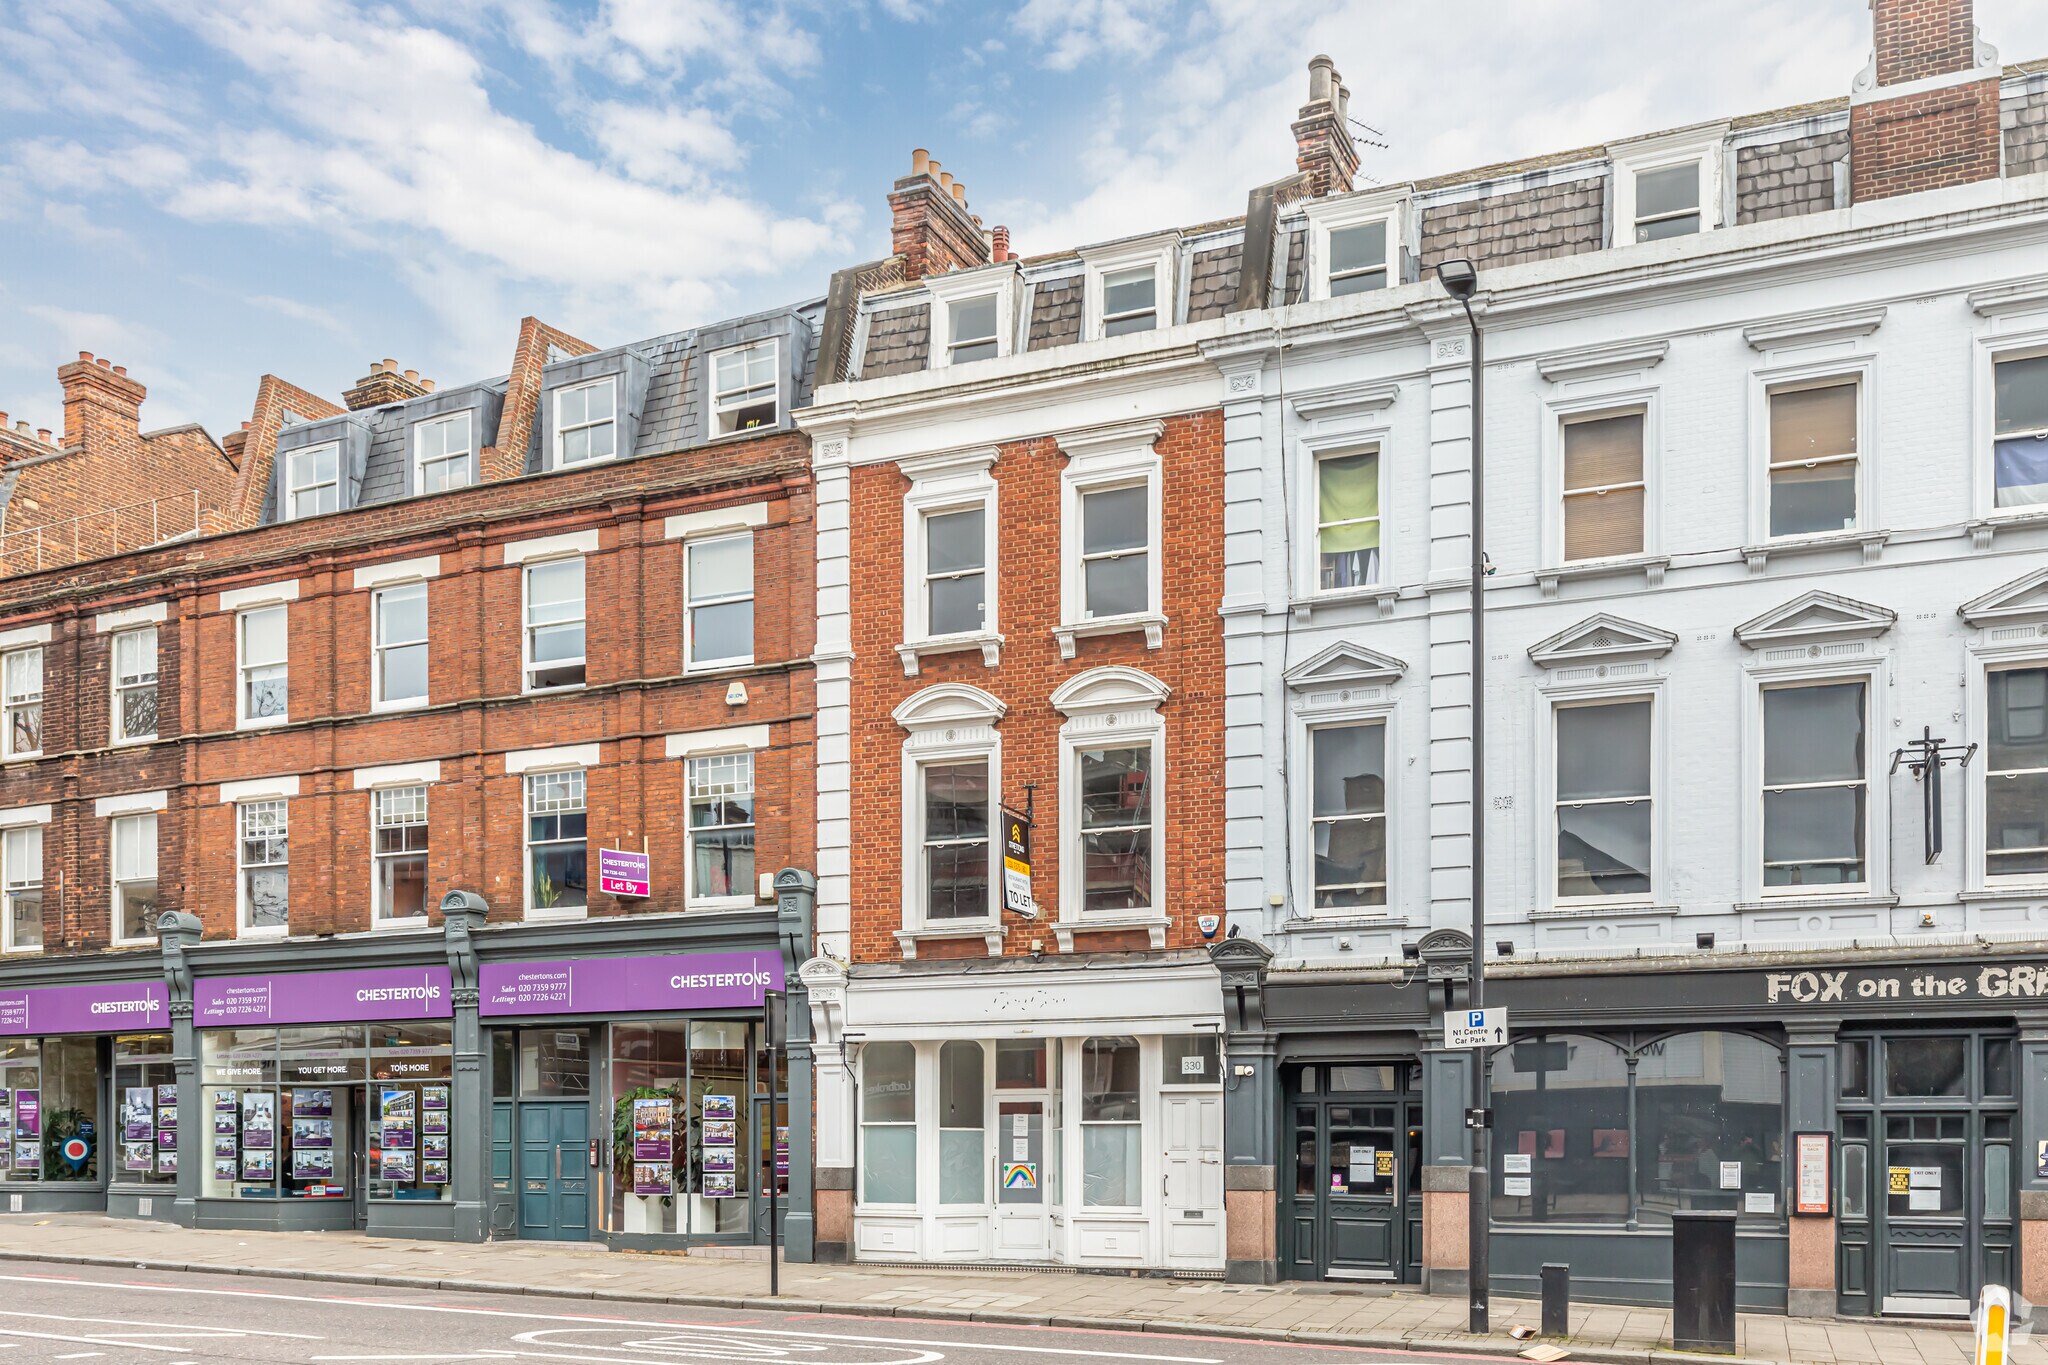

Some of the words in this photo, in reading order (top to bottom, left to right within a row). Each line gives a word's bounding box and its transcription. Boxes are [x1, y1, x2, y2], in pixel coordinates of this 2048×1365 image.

[602, 857, 646, 869] CHESTERTONS
[610, 879, 624, 891] Let
[626, 881, 637, 894] By
[1008, 889, 1019, 904] TO
[1019, 893, 1031, 908] LET
[518, 972, 567, 981] chestertons.com
[670, 971, 771, 989] CHESTERTONS
[226, 986, 267, 995] chestertons.com
[501, 985, 516, 993] Sales
[518, 984, 532, 992] 020
[532, 983, 549, 991] 7359
[550, 982, 567, 990] 9777
[1766, 971, 1849, 1003] FOX
[1857, 978, 1900, 998] on
[1910, 975, 1968, 997] the
[356, 986, 440, 1002] CHESTERTONS
[491, 995, 516, 1005] Lettings
[518, 993, 531, 1002] 020
[532, 993, 549, 1001] 7226
[550, 992, 566, 1000] 4221
[91, 1000, 160, 1014] CHESTERTONS
[211, 998, 225, 1006] Sales
[226, 997, 238, 1005] 020
[238, 996, 252, 1004] 7359
[203, 1007, 225, 1017] Lettings
[226, 1006, 238, 1014] 020
[238, 1006, 252, 1014] 7226
[252, 1005, 266, 1013] 4221
[1471, 1012, 1482, 1026] P
[215, 1068, 226, 1076] WE
[226, 1068, 241, 1076] GIVE
[242, 1067, 263, 1075] MORE.
[327, 1065, 348, 1073] MORE.
[390, 1064, 408, 1072] TONS
[409, 1063, 430, 1071] MORE
[1184, 1061, 1201, 1070] 330
